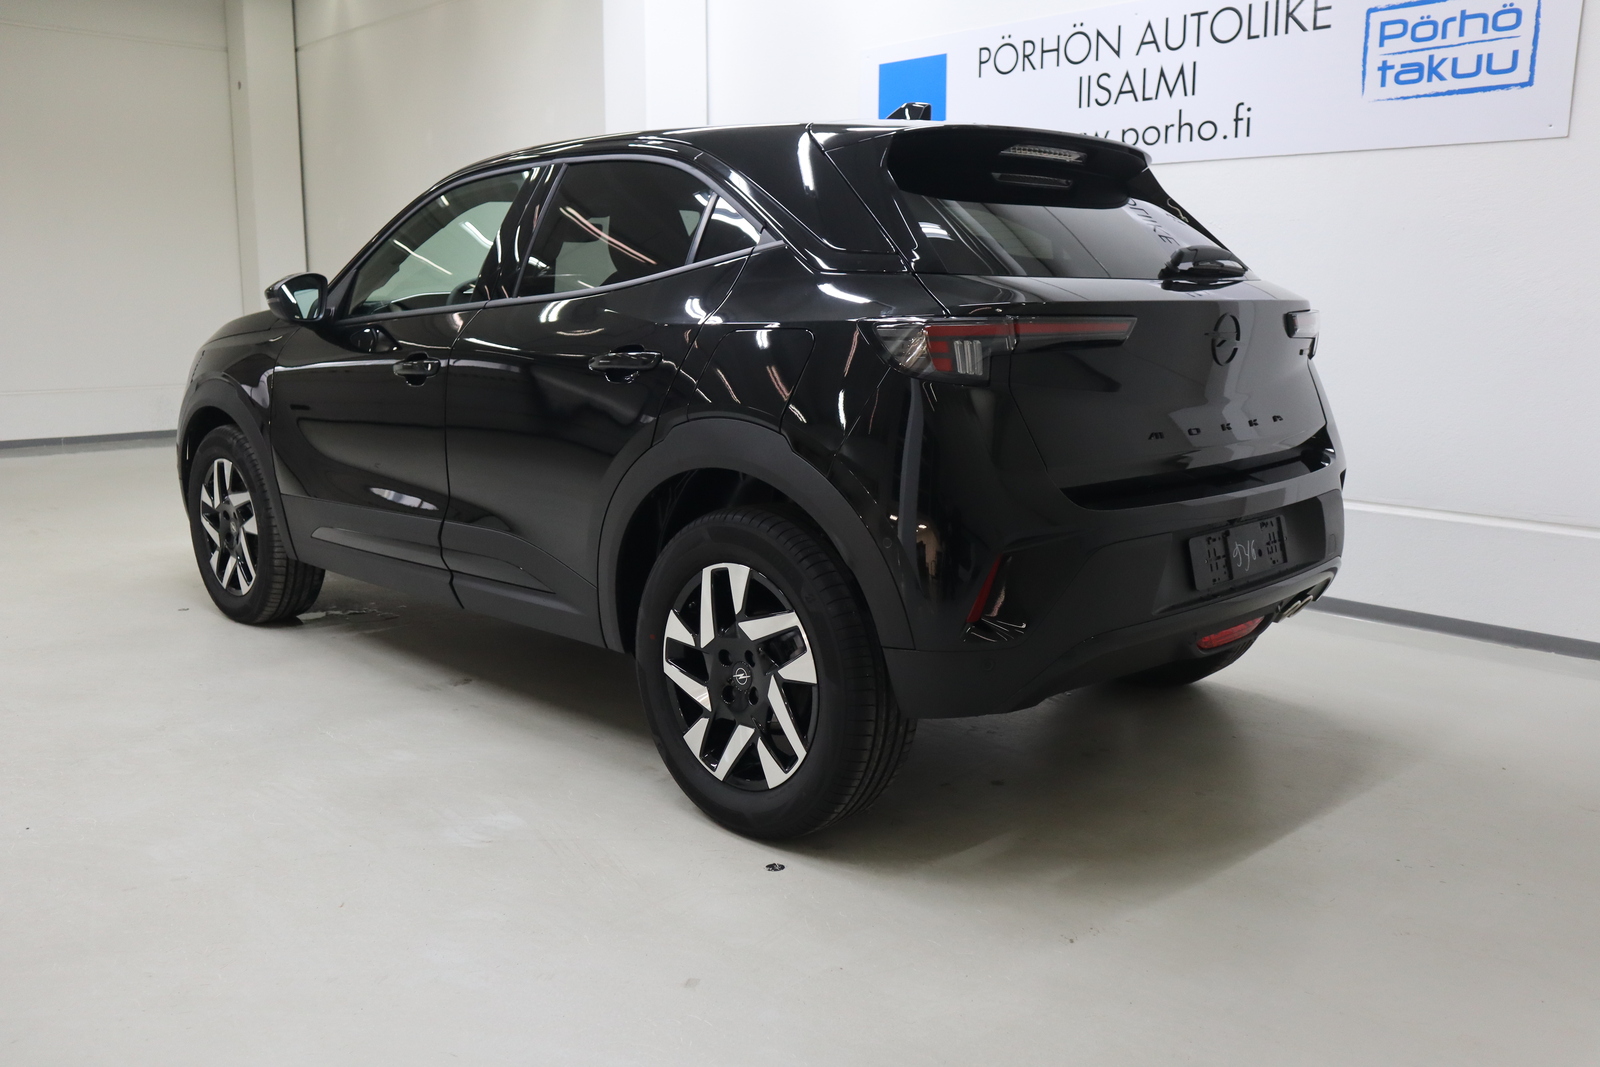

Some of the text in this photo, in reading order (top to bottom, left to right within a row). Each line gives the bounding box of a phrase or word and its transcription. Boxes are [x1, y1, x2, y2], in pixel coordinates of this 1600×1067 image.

[978, 0, 1333, 78] PÖRHÖN AUTOLIIKE
[1378, 2, 1523, 48] Pörhö
[1078, 61, 1197, 109] IISALMI
[1377, 49, 1520, 88] takuu
[1148, 414, 1284, 440] MOKKA
